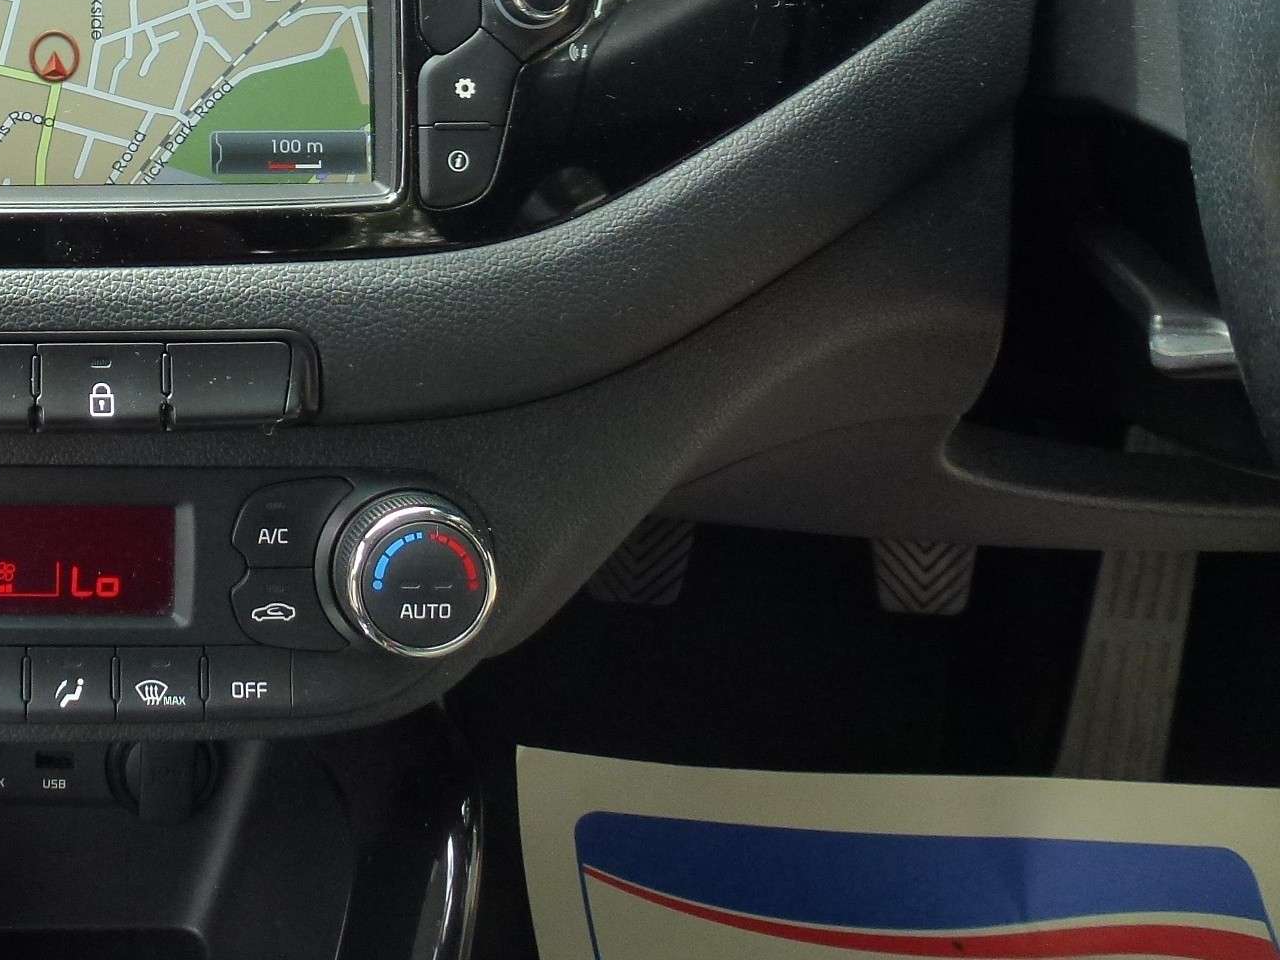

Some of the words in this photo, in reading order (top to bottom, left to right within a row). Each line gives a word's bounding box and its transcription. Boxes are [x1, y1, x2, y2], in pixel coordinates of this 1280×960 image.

[8, 111, 55, 128] Road
[164, 120, 197, 154] Park
[193, 80, 234, 119] Road
[112, 129, 147, 174] Road
[271, 139, 301, 153] 100
[307, 141, 323, 153] m
[258, 528, 289, 544] A/C
[71, 565, 120, 598] Lo
[400, 602, 451, 619] AUTO
[231, 681, 268, 699] OFF
[163, 695, 186, 706] MAX
[42, 778, 67, 790] USB
